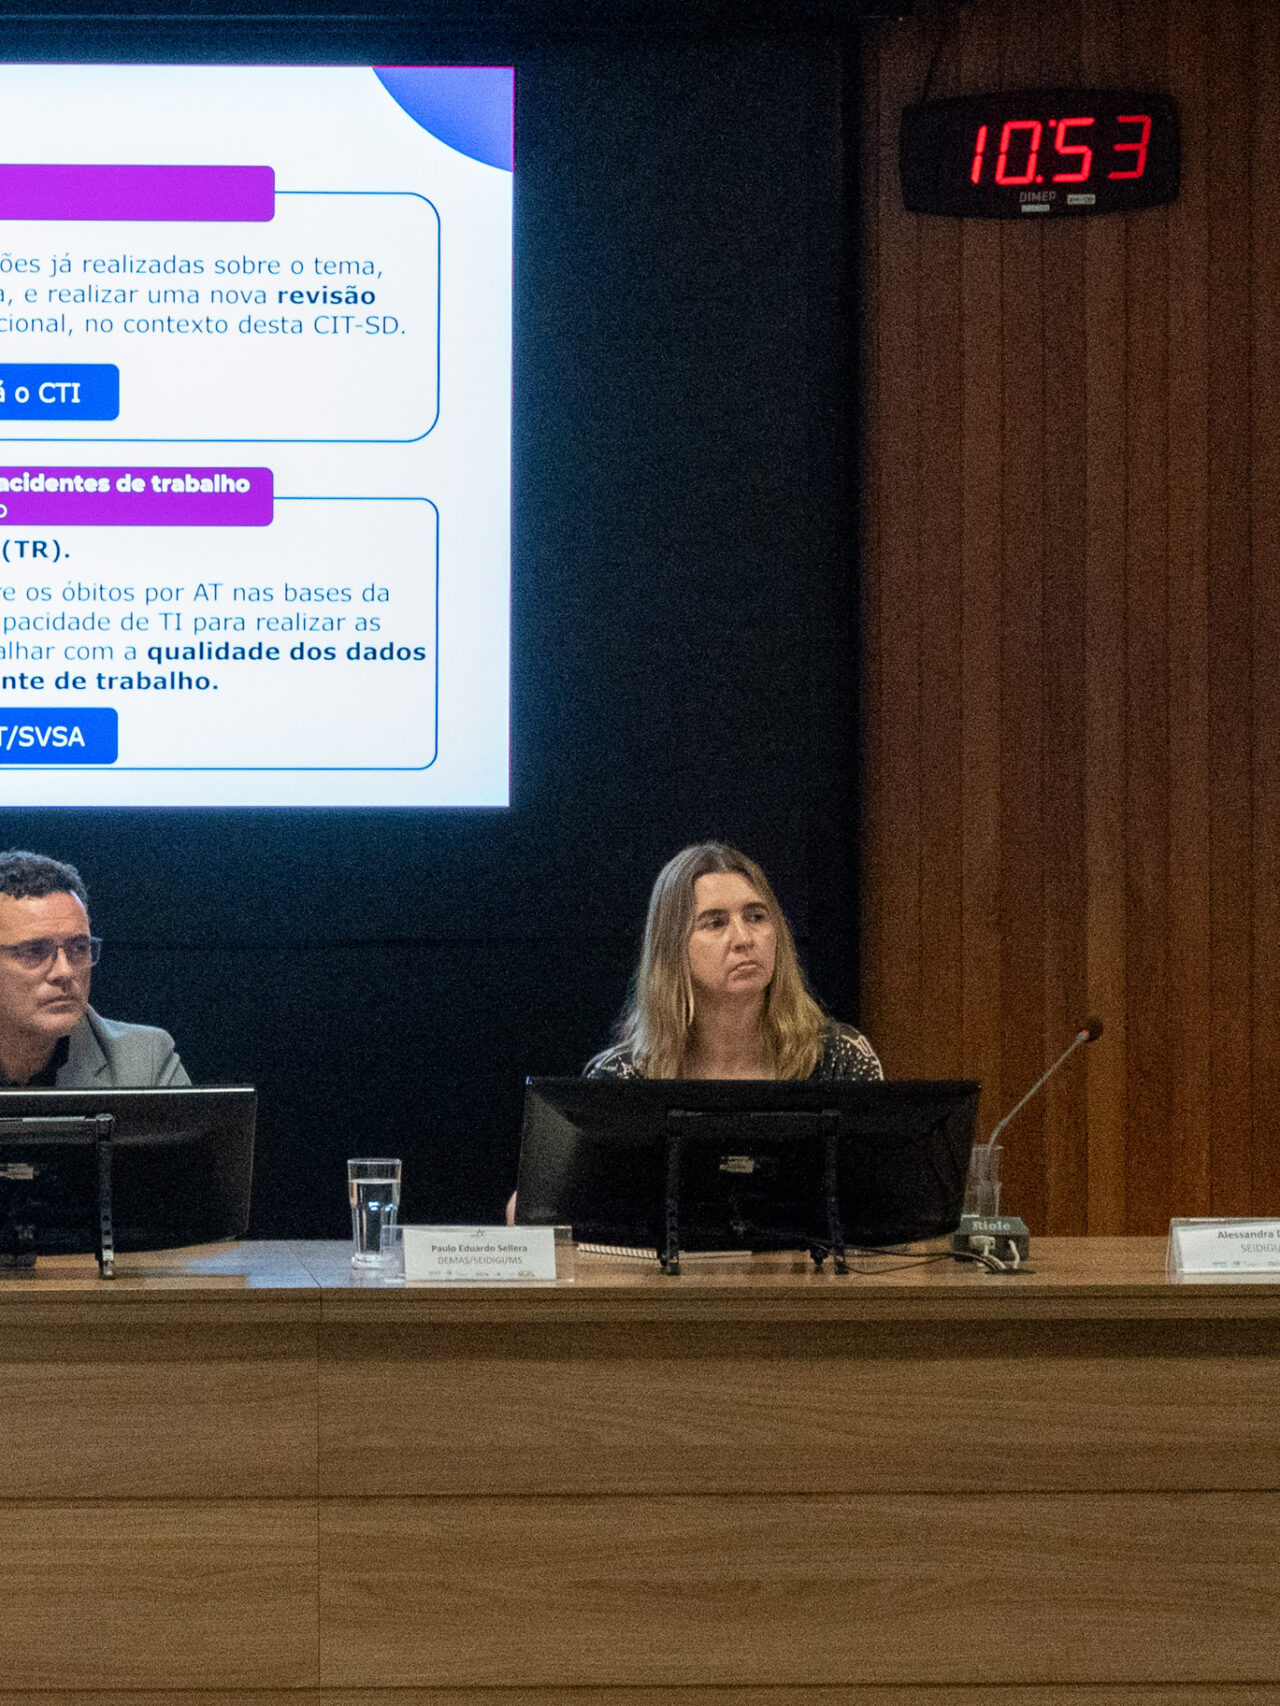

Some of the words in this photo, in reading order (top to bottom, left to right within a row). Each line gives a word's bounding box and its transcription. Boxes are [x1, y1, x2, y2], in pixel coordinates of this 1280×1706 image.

[50, 253, 72, 279] já
[83, 255, 205, 276] realizadas
[214, 255, 281, 277] sobre
[290, 260, 304, 276] o
[314, 257, 383, 281] tema,
[24, 289, 38, 305] e
[48, 284, 139, 305] realizar
[148, 289, 200, 306] uma
[210, 290, 267, 306] nova
[277, 285, 376, 307] revisão
[85, 319, 114, 335] no
[123, 316, 229, 336] contexto
[238, 315, 303, 336] desta
[313, 315, 406, 337] CIT-SD.
[14, 387, 30, 405] o
[38, 382, 81, 405] CTI
[115, 474, 146, 494] de
[150, 474, 251, 495] trabalho
[2, 539, 70, 565] (TR).
[25, 587, 53, 603] os
[61, 581, 135, 604] óbitos
[145, 587, 185, 608] por
[193, 583, 223, 603] AT
[233, 587, 275, 604] nas
[284, 583, 352, 604] bases
[361, 583, 390, 604] da
[120, 612, 149, 633] de
[158, 612, 182, 633] TI
[193, 617, 246, 637] para
[256, 612, 347, 633] realizar
[354, 617, 381, 633] as
[63, 646, 114, 662] com
[123, 646, 137, 662] a
[147, 641, 281, 667] qualidade
[289, 641, 337, 663] dos
[345, 641, 427, 663] dados
[54, 671, 87, 692] de
[95, 671, 219, 692] trabalho.
[431, 1244, 457, 1253] Paulo
[458, 1244, 496, 1253] Eduardo
